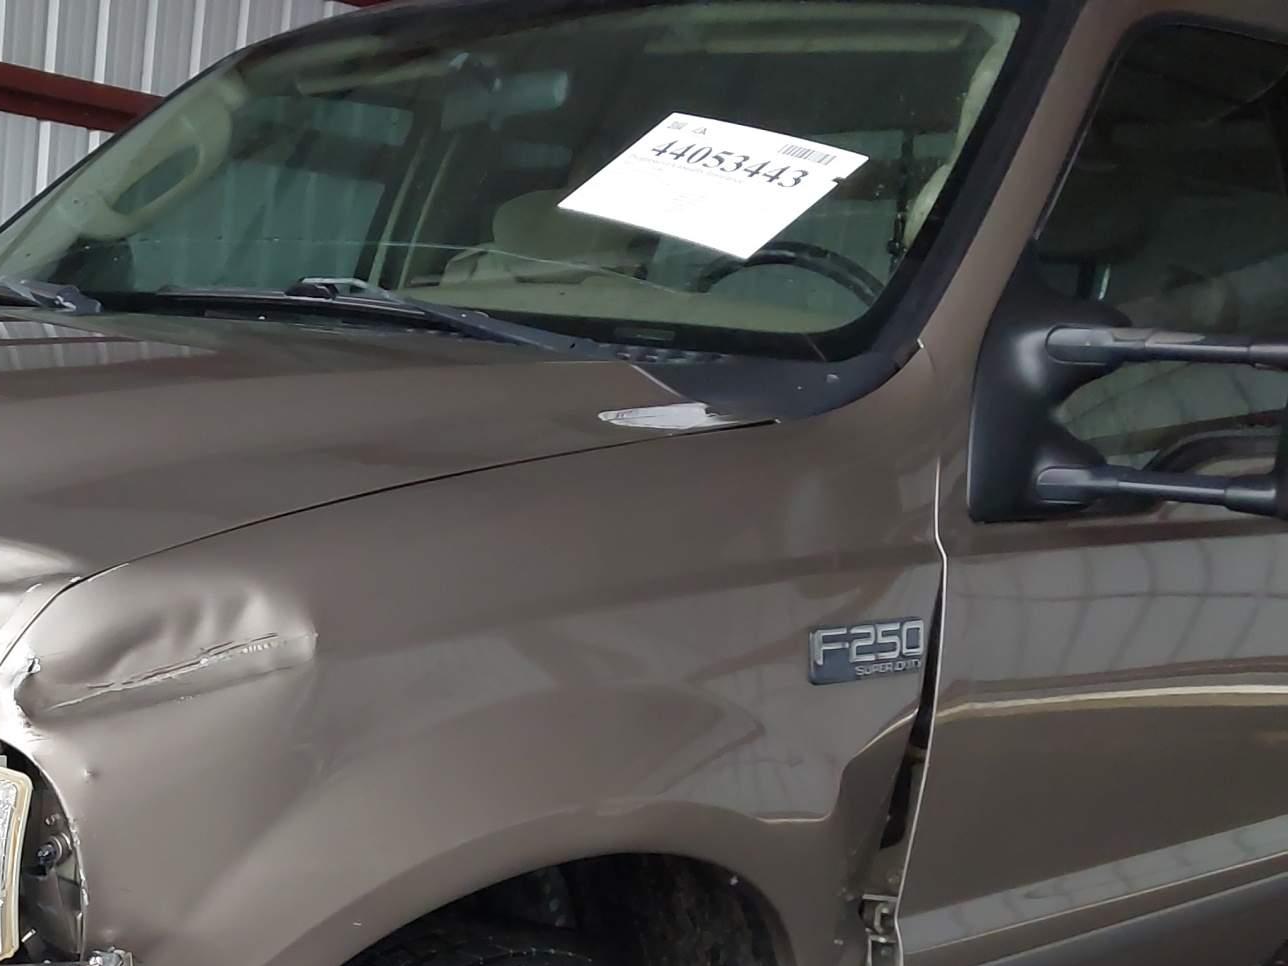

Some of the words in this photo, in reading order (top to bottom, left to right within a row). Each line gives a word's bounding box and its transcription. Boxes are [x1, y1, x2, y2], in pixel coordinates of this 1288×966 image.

[651, 140, 809, 188] 44053443
[815, 620, 924, 665] F250
[855, 662, 893, 675] SUPER
